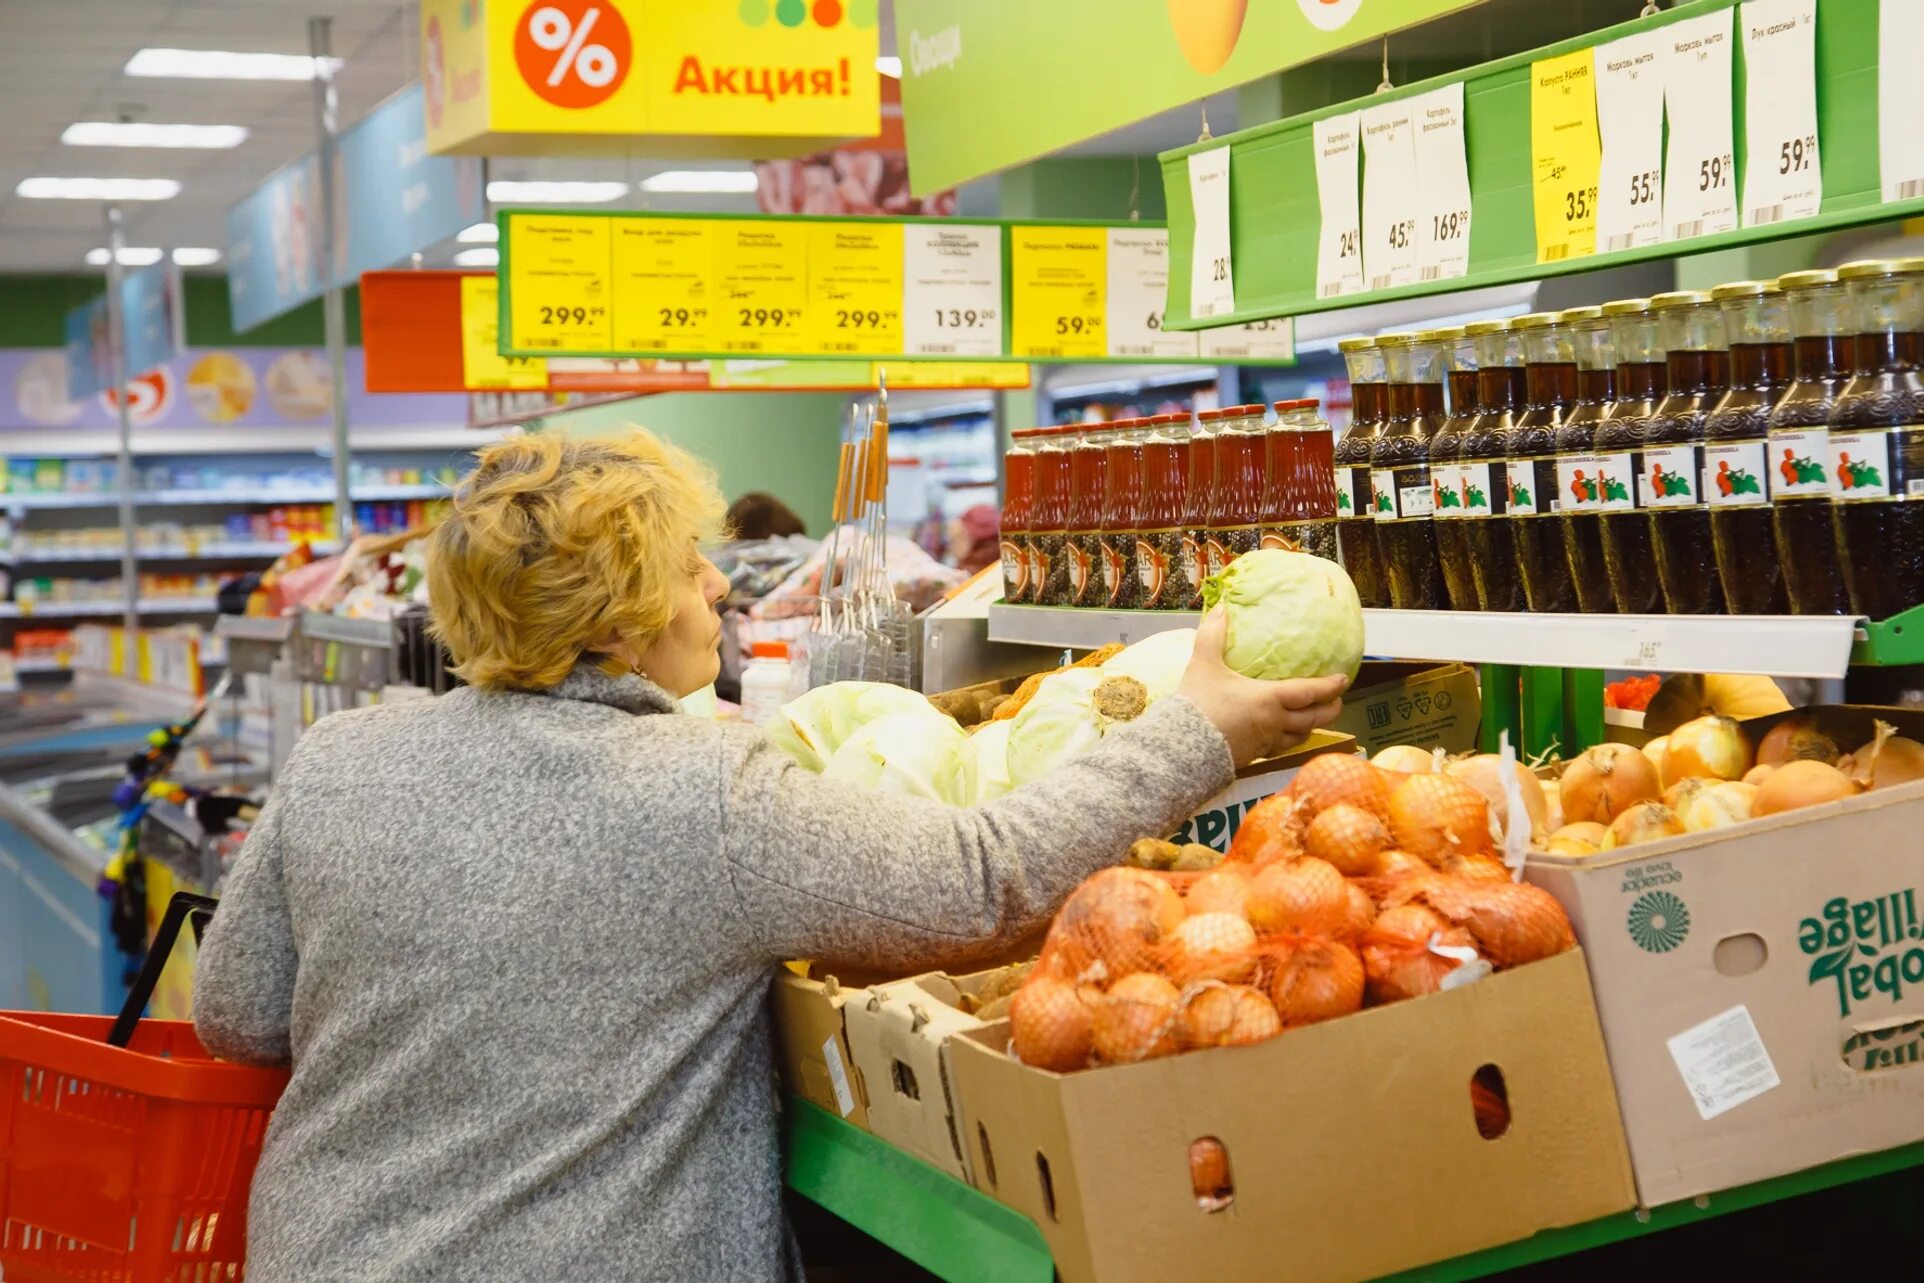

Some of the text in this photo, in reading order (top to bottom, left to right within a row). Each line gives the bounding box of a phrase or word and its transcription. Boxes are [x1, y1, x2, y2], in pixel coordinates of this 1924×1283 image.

[1674, 32, 1724, 54] Морковь мытая
[1751, 27, 1765, 41] Лук
[1767, 16, 1797, 36] красный
[673, 56, 851, 102] Акция!
[1540, 65, 1588, 88] Капуста РАННЯЯ
[1606, 52, 1654, 73] Морковь мытая
[1779, 135, 1815, 175] 59.99
[1699, 153, 1731, 192] 59.99
[1566, 186, 1598, 222] 35.99
[1433, 210, 1469, 242] 169.99
[1798, 888, 1924, 955] illage
